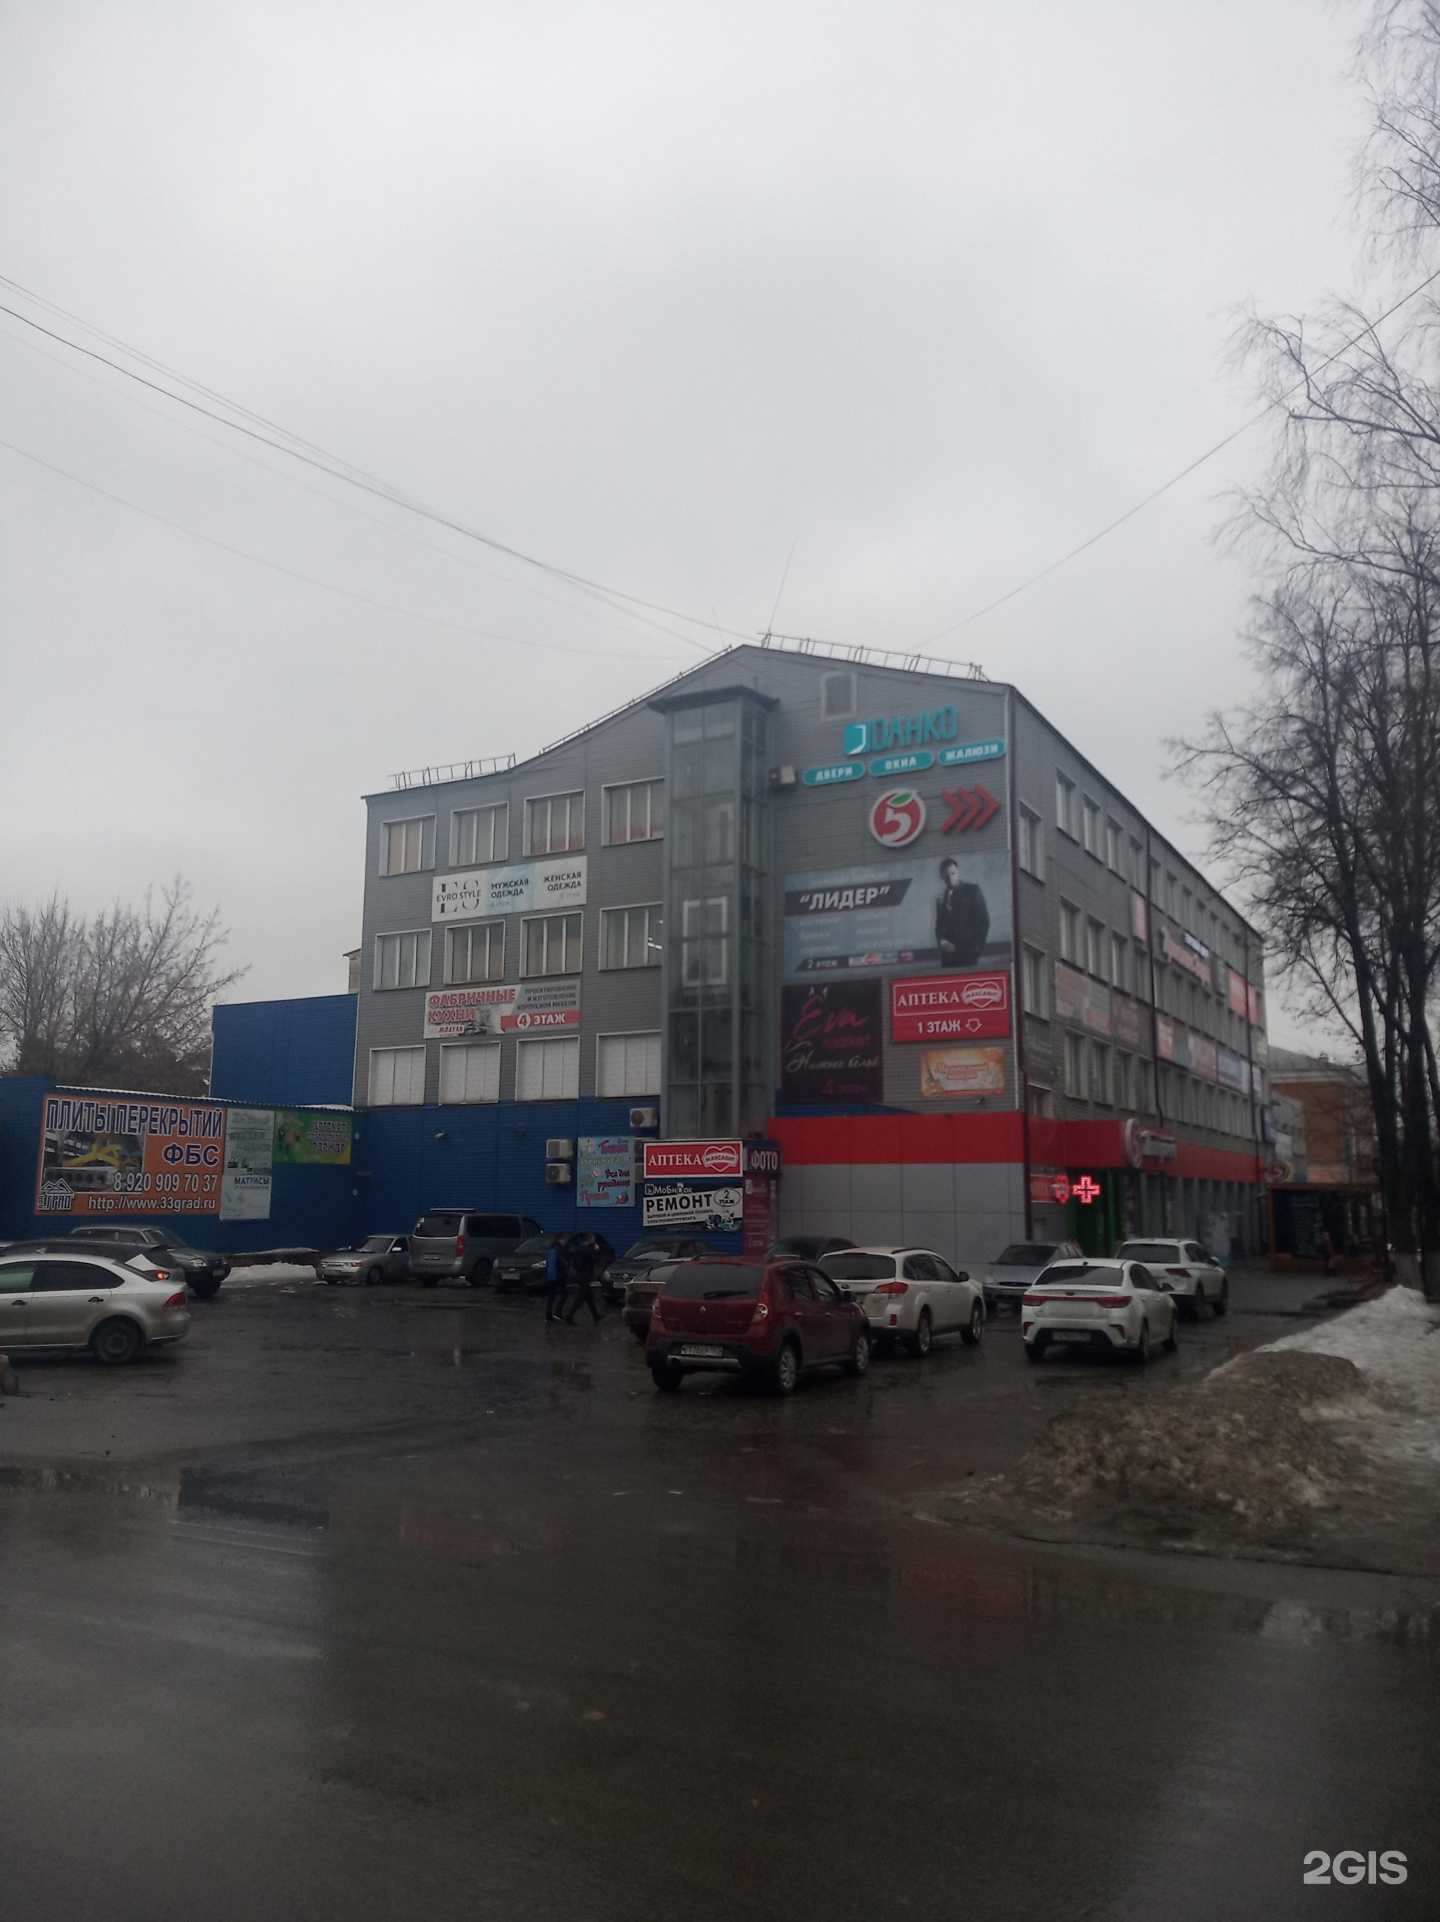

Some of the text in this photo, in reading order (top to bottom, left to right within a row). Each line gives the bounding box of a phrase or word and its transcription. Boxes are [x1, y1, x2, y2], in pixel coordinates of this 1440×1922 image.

[815, 743, 1000, 783] ДВЕРИ ОКНА ЖАЛЮЗИ
[490, 877, 530, 890] МУЖСКАЯ
[543, 871, 582, 883] ЖЕНСКАЯ
[490, 888, 525, 899] ОДЕЖДА
[546, 880, 582, 892] ОДЕЖДА
[436, 888, 482, 903] EVRO STYLE
[429, 988, 517, 1009] ФАБРИЧНЫЕ
[897, 991, 960, 1008] АПТЕКА
[533, 1012, 566, 1025] ЭТАЖ
[917, 1019, 961, 1034] 1 ЭТАЖ
[46, 1099, 113, 1132] ПЛИТЫ
[114, 1104, 223, 1138] ПЕРЕКРЫТИЙ
[163, 1143, 220, 1168] ФБС
[648, 1153, 704, 1167] АПТЕКА
[750, 1150, 778, 1171] ФОТО
[113, 1172, 218, 1192] 8 920 909 70 37
[234, 1176, 270, 1186] МАТРАСЫ
[724, 1190, 731, 1199] 2
[88, 1196, 216, 1213] http://www.33grad.ru
[646, 1193, 713, 1213] РЕМОНТ
